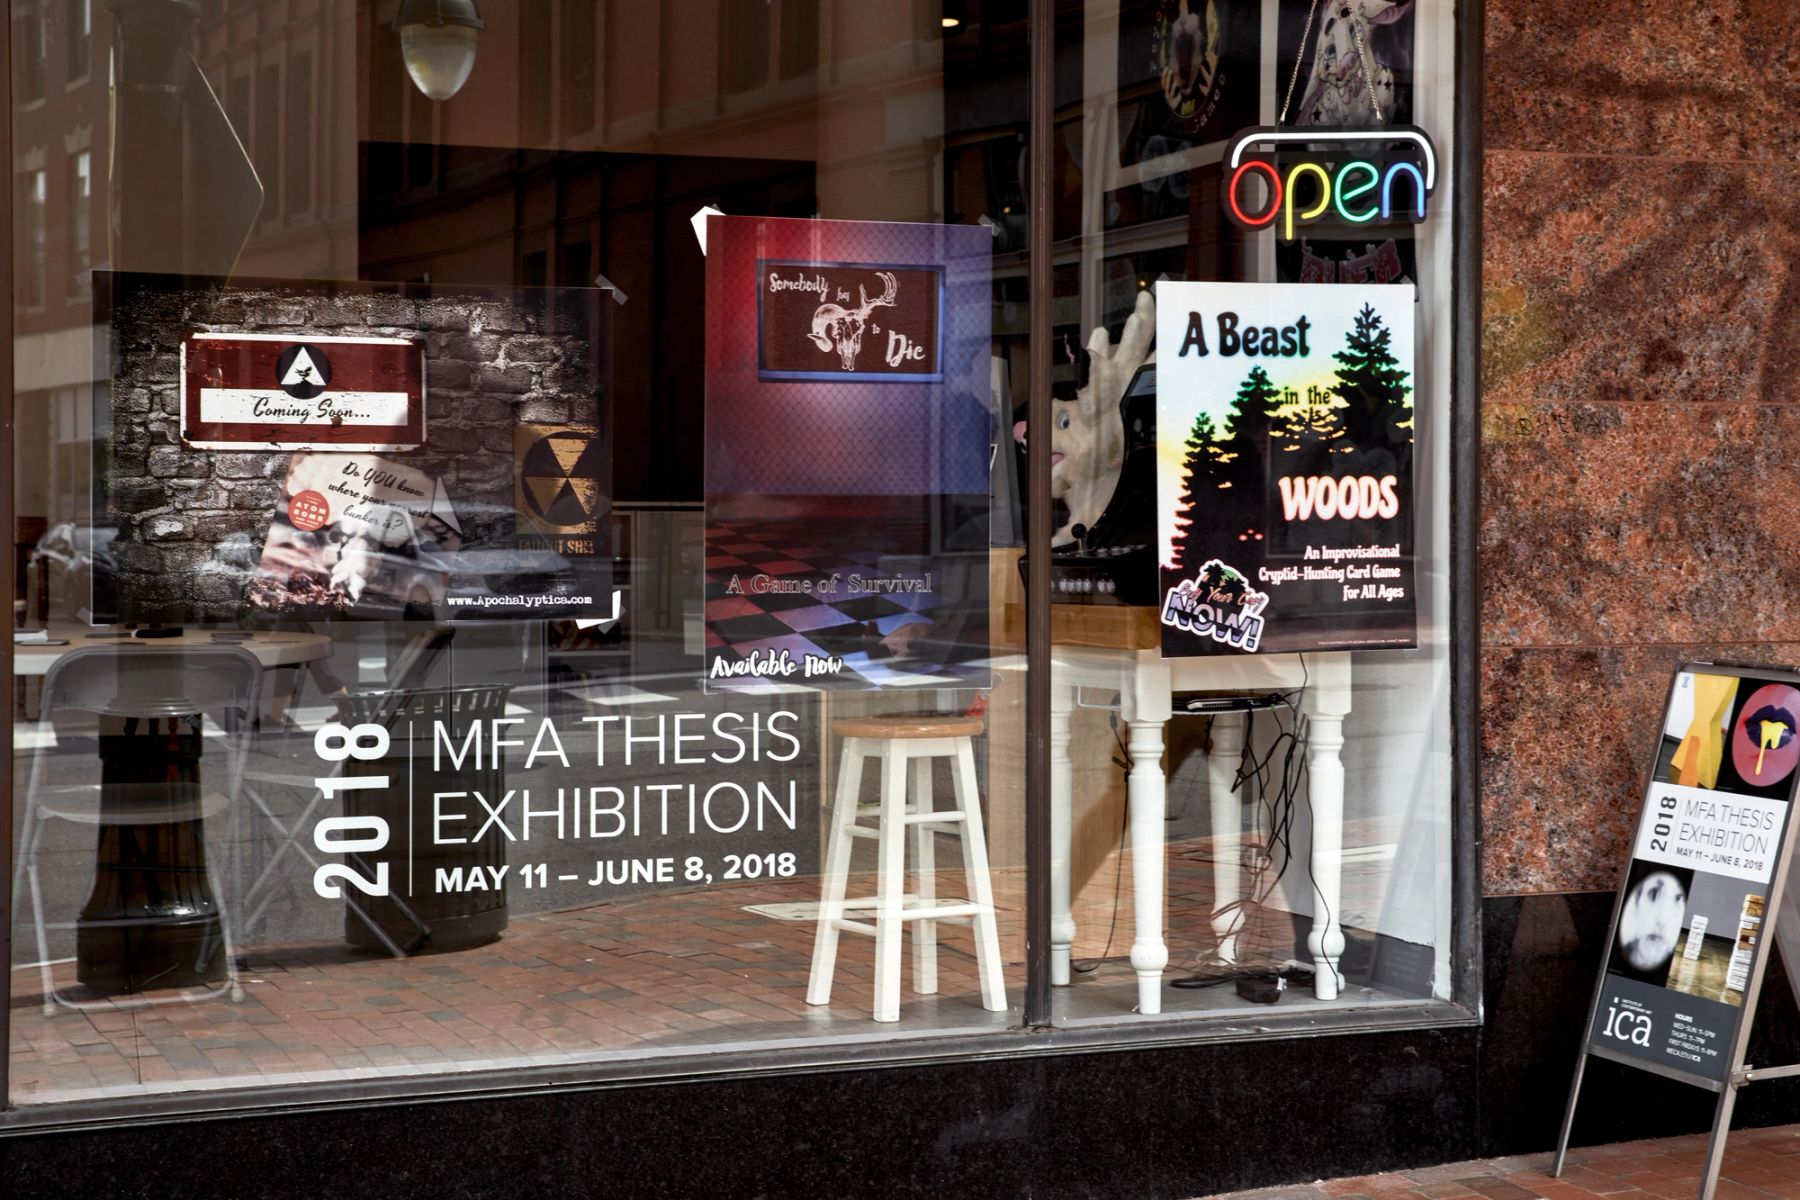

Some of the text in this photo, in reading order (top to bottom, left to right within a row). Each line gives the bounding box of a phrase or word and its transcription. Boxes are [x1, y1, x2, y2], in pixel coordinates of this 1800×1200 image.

[769, 272, 830, 302] Somebody
[871, 323, 881, 334] to
[1178, 311, 1312, 358] A Beast
[885, 329, 926, 367] Die
[253, 396, 312, 424] Coming
[1284, 385, 1331, 405] in the
[328, 481, 360, 499] where
[342, 461, 425, 497] Do YOU know
[295, 500, 327, 516] ATOM
[1277, 474, 1400, 521] WOODS
[343, 504, 379, 526] bunker
[1303, 543, 1401, 564] An Improvisational
[726, 572, 932, 594] A Game of Survival
[1346, 564, 1371, 579] Card
[1372, 563, 1401, 579] Game
[446, 594, 593, 608] www.Apochalyptica.com
[1342, 583, 1405, 602] for All Ages
[1164, 590, 1262, 649] NOW!
[709, 648, 843, 679] Available Now
[433, 711, 801, 772] MFA THESIS
[313, 722, 391, 899] 2018
[433, 779, 797, 845] EXHIBITION
[1650, 796, 1678, 852] 2018
[1684, 799, 1776, 831] MFA THESIS
[1678, 822, 1769, 855] EXHIBITION
[434, 865, 509, 893] MAY
[518, 862, 547, 890] 11
[588, 857, 674, 887] JUNE
[684, 856, 713, 886] 8,
[722, 852, 797, 880] 2018
[1675, 846, 1693, 858] MAY
[1694, 850, 1703, 860] 11
[1709, 852, 1732, 866] JUNE
[1743, 858, 1765, 871] 2018
[1602, 996, 1653, 1048] ica
